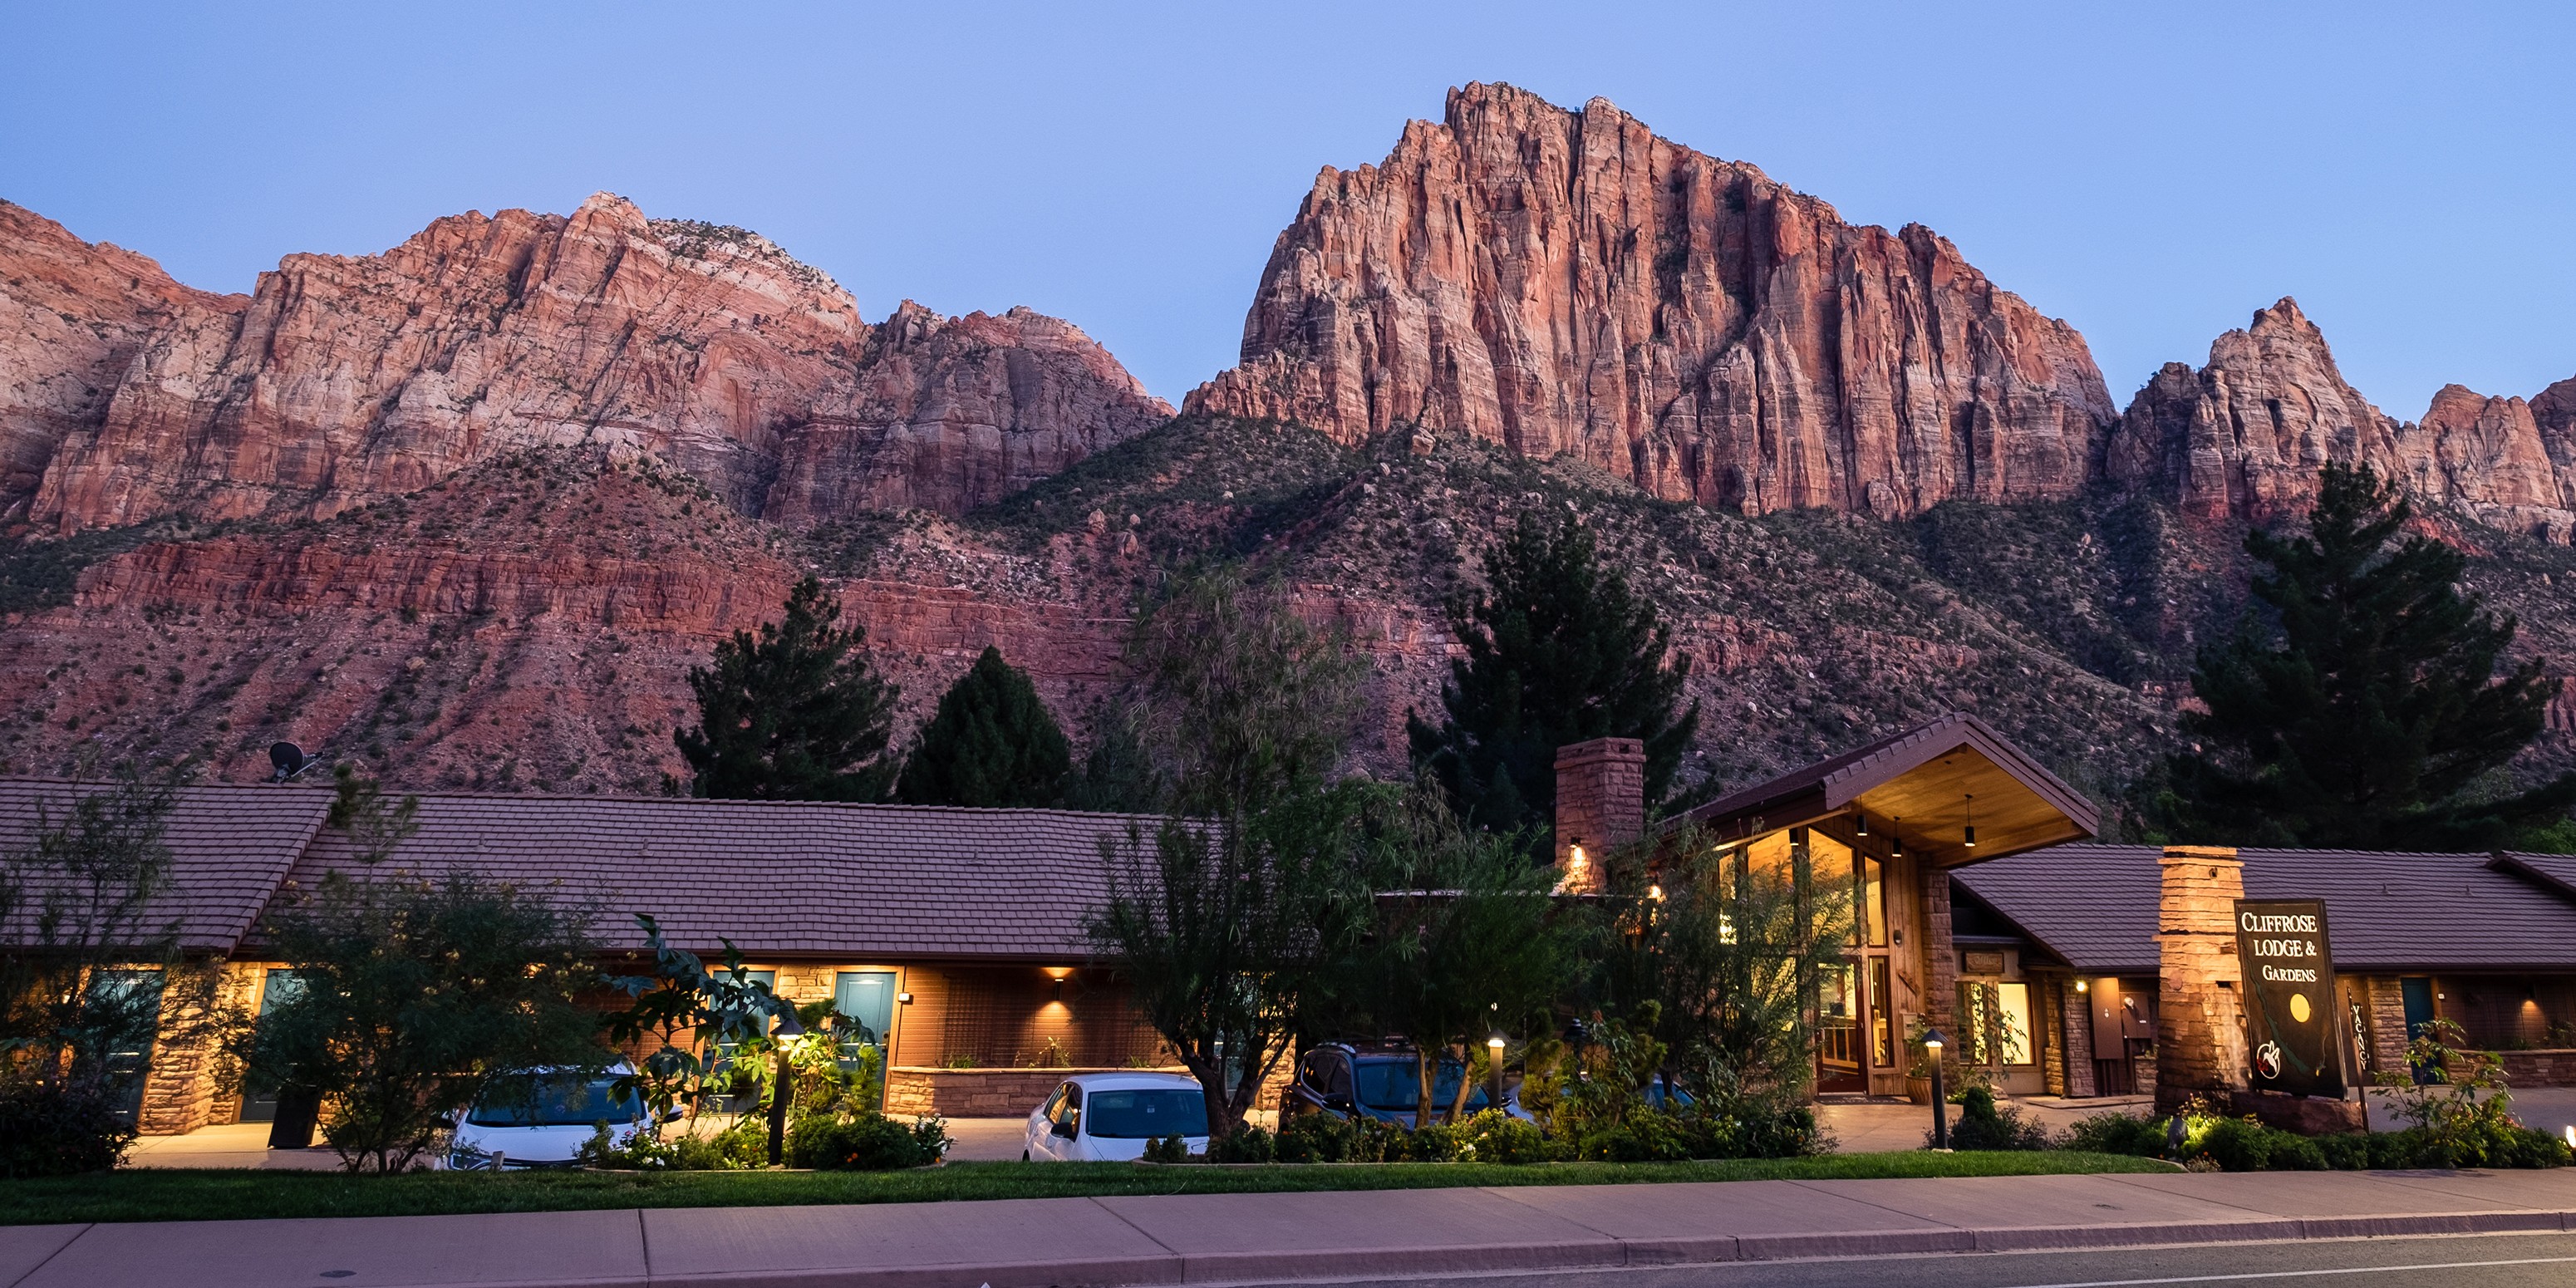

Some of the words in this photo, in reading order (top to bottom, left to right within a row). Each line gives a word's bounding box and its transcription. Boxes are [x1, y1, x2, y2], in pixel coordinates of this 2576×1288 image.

[2241, 912, 2318, 932] CLIFFROSE
[2254, 939, 2302, 956] LODGE
[2305, 941, 2317, 956] &
[2262, 965, 2316, 982] GARDENS
[2352, 1005, 2367, 1070] VACANCY
